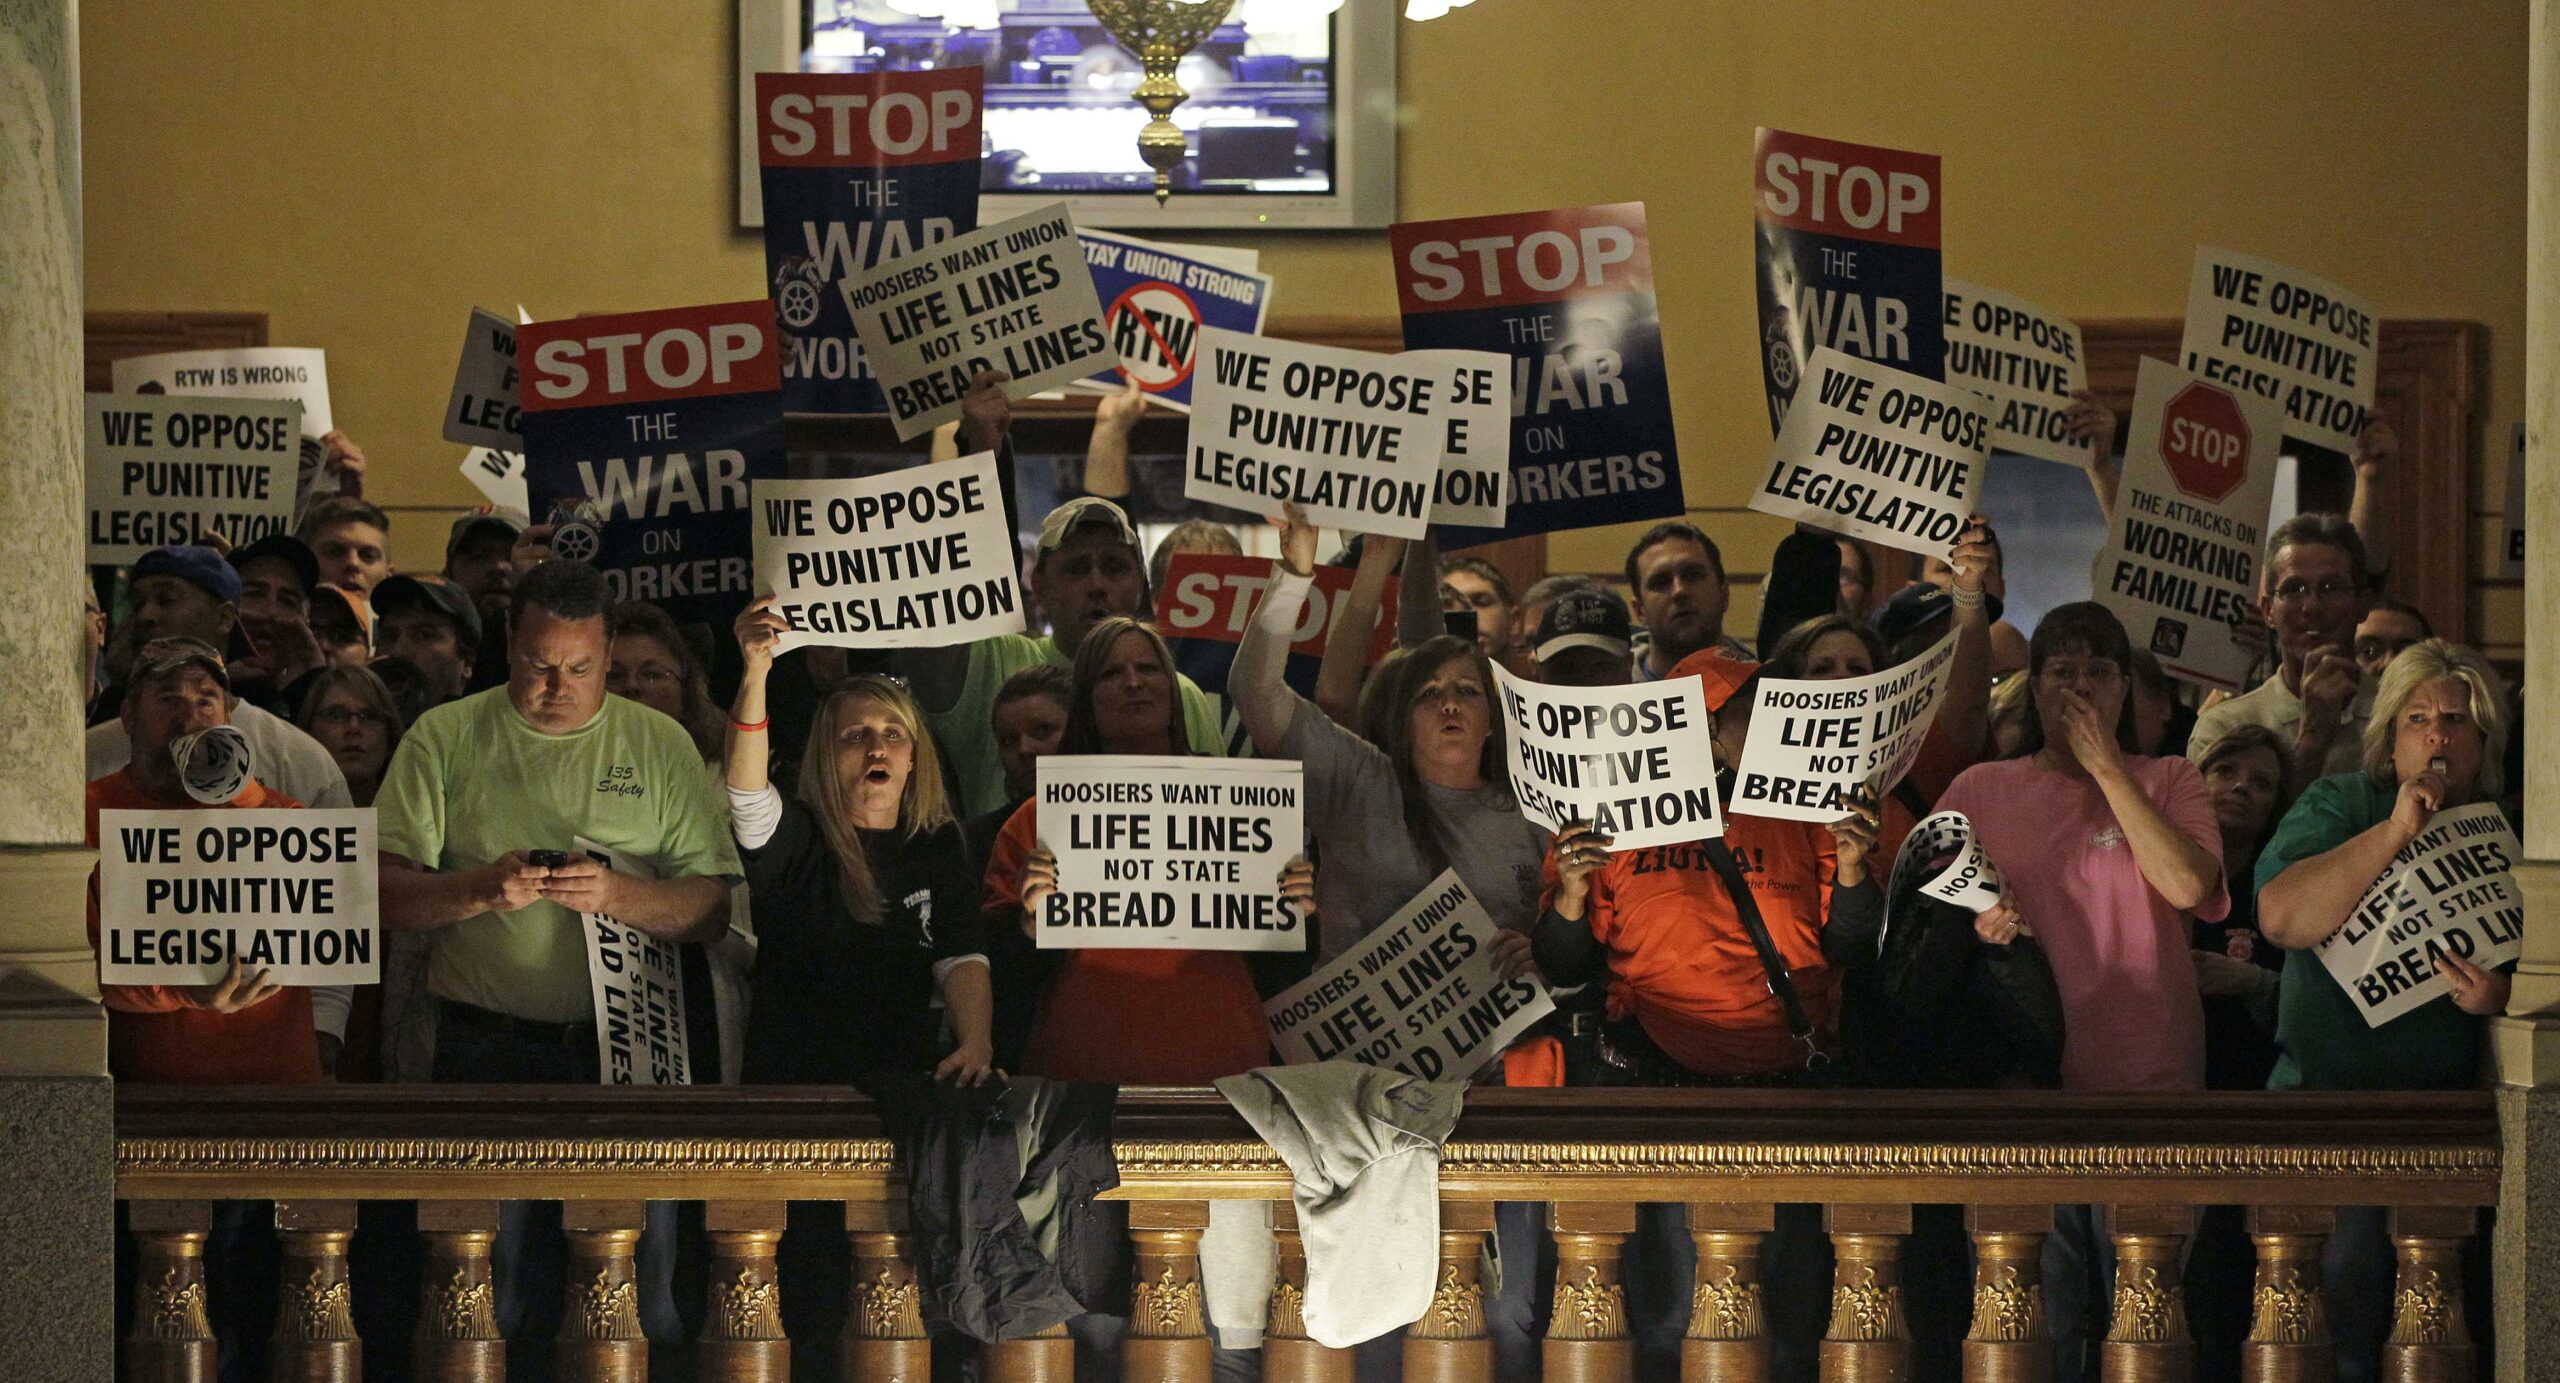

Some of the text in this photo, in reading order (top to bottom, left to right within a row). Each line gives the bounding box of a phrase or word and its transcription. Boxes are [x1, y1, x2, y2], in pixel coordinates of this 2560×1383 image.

[770, 90, 973, 156] STOP
[849, 179, 899, 207] THE
[1764, 152, 1930, 233] STOP
[851, 218, 1068, 309] HOOSIERS WANT UNION
[1124, 249, 1183, 285] UNION
[1185, 265, 1256, 305] STRONG
[1409, 226, 1634, 301] STOP
[1821, 248, 1857, 279] THE
[880, 254, 1061, 345] LIFE LINES
[1944, 294, 2077, 363] E OPPOSE
[2212, 264, 2371, 349] WE OPPOSE
[919, 331, 961, 365] NOT
[974, 303, 1044, 345] STATE
[1002, 317, 1106, 381] LINES
[1503, 315, 1555, 344] THE
[2221, 314, 2358, 388] PUNITIVE
[175, 366, 308, 387] RTW IS WRONG
[534, 323, 763, 400] STOP
[1215, 347, 1271, 392] WE
[1283, 361, 1433, 415] OPPOSE
[1950, 341, 2070, 397] UNITIVE
[102, 411, 288, 451] WE OPPOSE
[626, 413, 678, 442] THE
[1228, 403, 1402, 462] PUNITIVE
[1819, 367, 1875, 416] WE
[1879, 388, 1988, 453] OPPOSE
[1525, 426, 1565, 454] ON
[1815, 422, 1969, 500] PUNITIVE
[2170, 416, 2241, 468] STOP
[122, 461, 270, 500] PUNITIVE
[577, 449, 749, 522] WAR
[765, 474, 984, 536] WE OPPOSE
[1194, 445, 1426, 519] LEGISLATION
[1507, 450, 1666, 507] RKERS
[91, 510, 287, 548] LEGISLATION
[642, 529, 681, 554] ON
[2131, 489, 2257, 545] THE ATTACKS ON
[602, 557, 747, 605] ORKER
[787, 531, 971, 589] PUNITIVE
[2124, 518, 2252, 586] WORKING
[781, 577, 1015, 634] EGISLATION
[2111, 560, 2247, 624] FAMILIES
[1502, 680, 1688, 740] WE OPPOSE
[1764, 689, 1868, 710] HOOSIERS
[1875, 669, 1918, 703] WANT
[1780, 677, 1937, 748] LIFE LINES
[608, 765, 634, 779] 135
[1519, 736, 1671, 789] PUNITIVE
[1808, 727, 1913, 773] NOT STATE
[596, 780, 645, 799] Safety
[1046, 783, 1295, 808] HOOSIERS WANT UNION
[121, 827, 358, 863] WE OPPOSE
[1071, 814, 1273, 853] LIFE LINES
[2396, 814, 2507, 868] WANT UNION
[146, 878, 334, 914] PUNITIVE
[1104, 859, 1240, 883] NOT STATE
[1767, 879, 1801, 891] Power
[2343, 880, 2417, 946] LIFE
[2414, 841, 2511, 896] LINES
[1046, 891, 1297, 932] BREAD LINES
[2385, 909, 2434, 946] NOT
[2438, 881, 2508, 919] STATE
[110, 928, 371, 965] LEGISLATION
[1269, 883, 1467, 1035] HOOSIERS WANT UNION
[2353, 928, 2475, 1008] BREAD
[626, 931, 647, 1047] OT STATE
[668, 989, 682, 1048] WANT
[1303, 922, 1477, 1062] LIFE LINES
[1442, 976, 1536, 1058] LINES
[604, 984, 632, 1085] LINES
[646, 979, 671, 1085] LINES
[1355, 1028, 1402, 1067] NOT
[1407, 976, 1471, 1037] STATE
